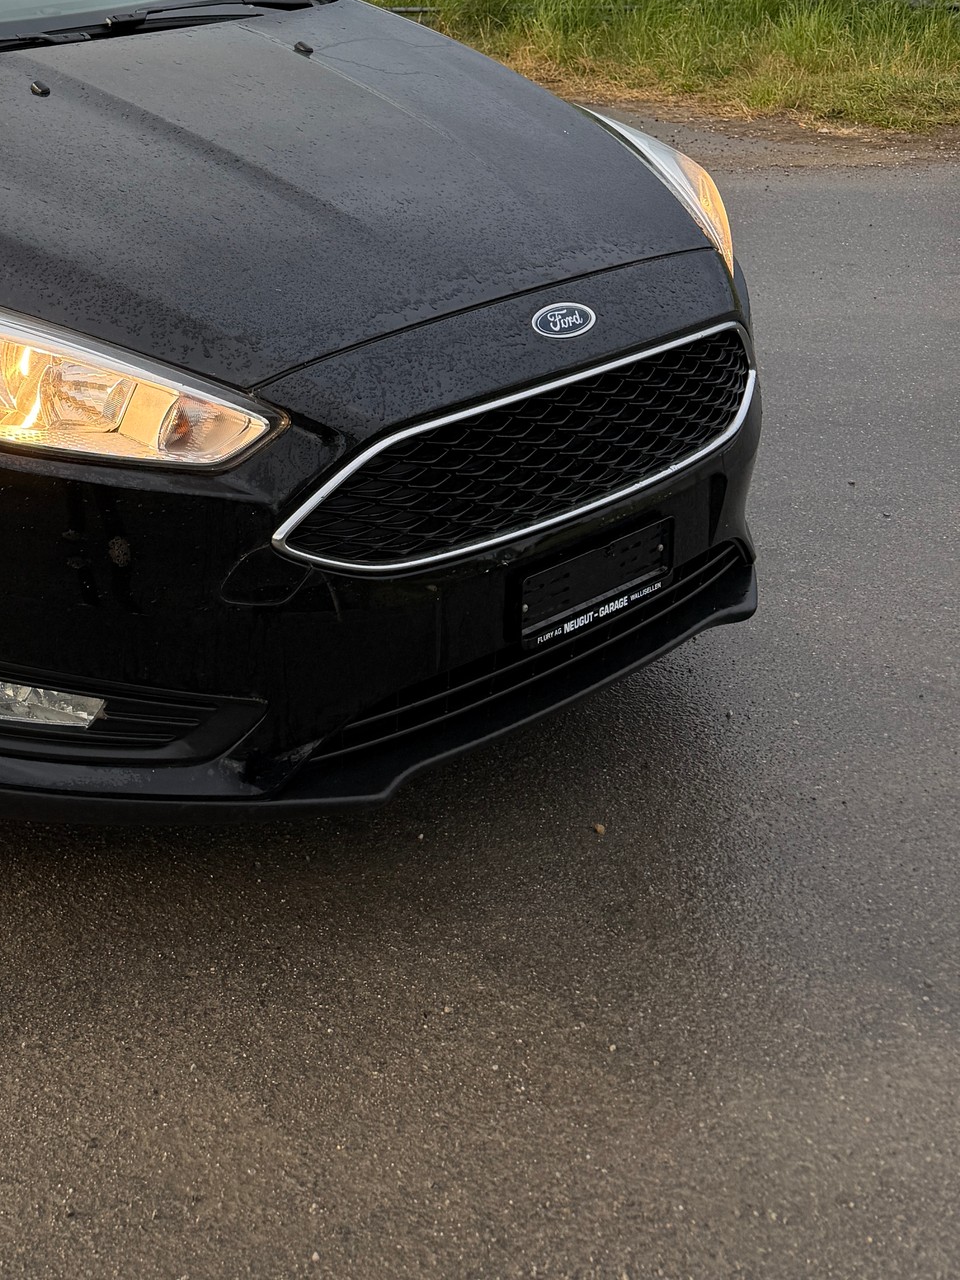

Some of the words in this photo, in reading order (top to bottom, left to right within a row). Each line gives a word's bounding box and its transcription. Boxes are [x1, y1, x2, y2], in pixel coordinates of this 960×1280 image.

[547, 309, 583, 331] Ford
[537, 631, 554, 644] FLURY
[554, 627, 562, 637] AG
[629, 581, 662, 601] WALLISELLEN
